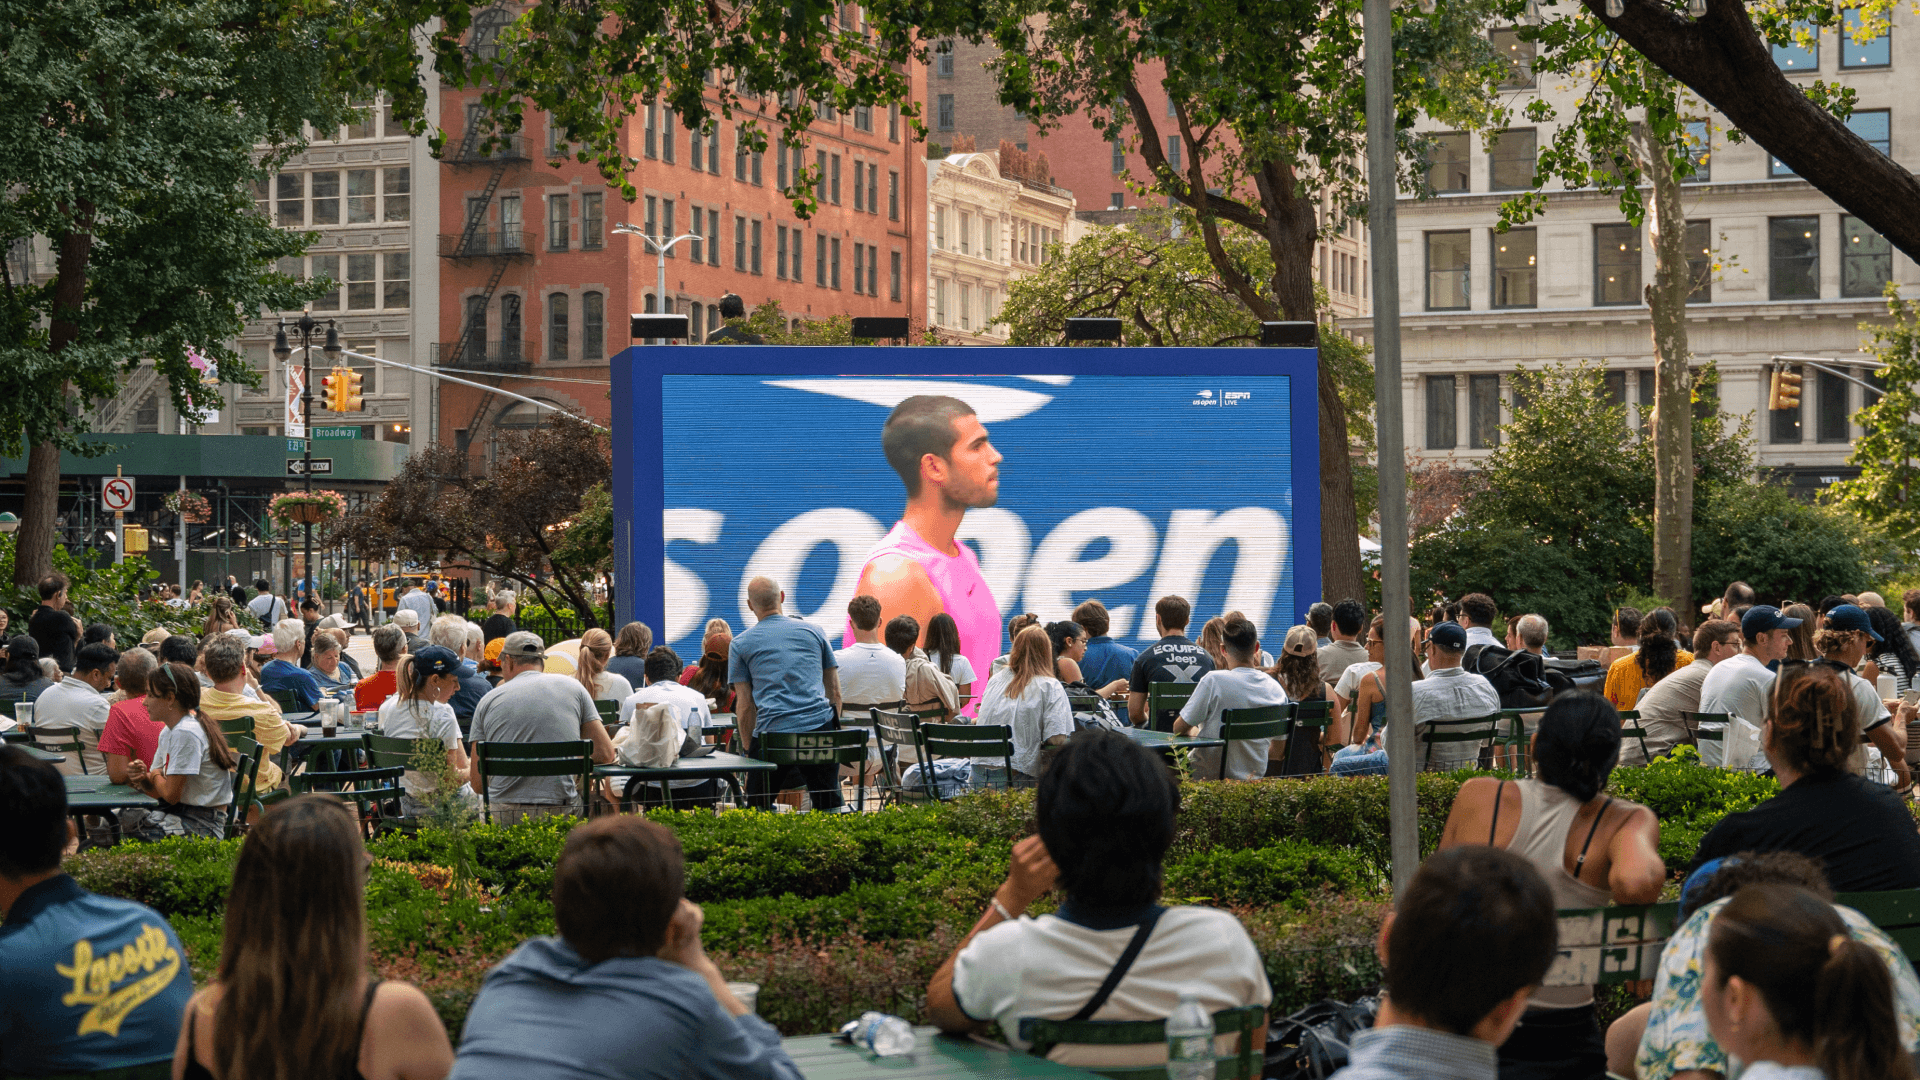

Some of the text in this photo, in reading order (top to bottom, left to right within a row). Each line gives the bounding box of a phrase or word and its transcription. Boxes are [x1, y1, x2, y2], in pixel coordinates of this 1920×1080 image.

[316, 429, 356, 439] Broadway
[1153, 644, 1205, 655] EQUIPE
[1166, 653, 1197, 664] Jeep
